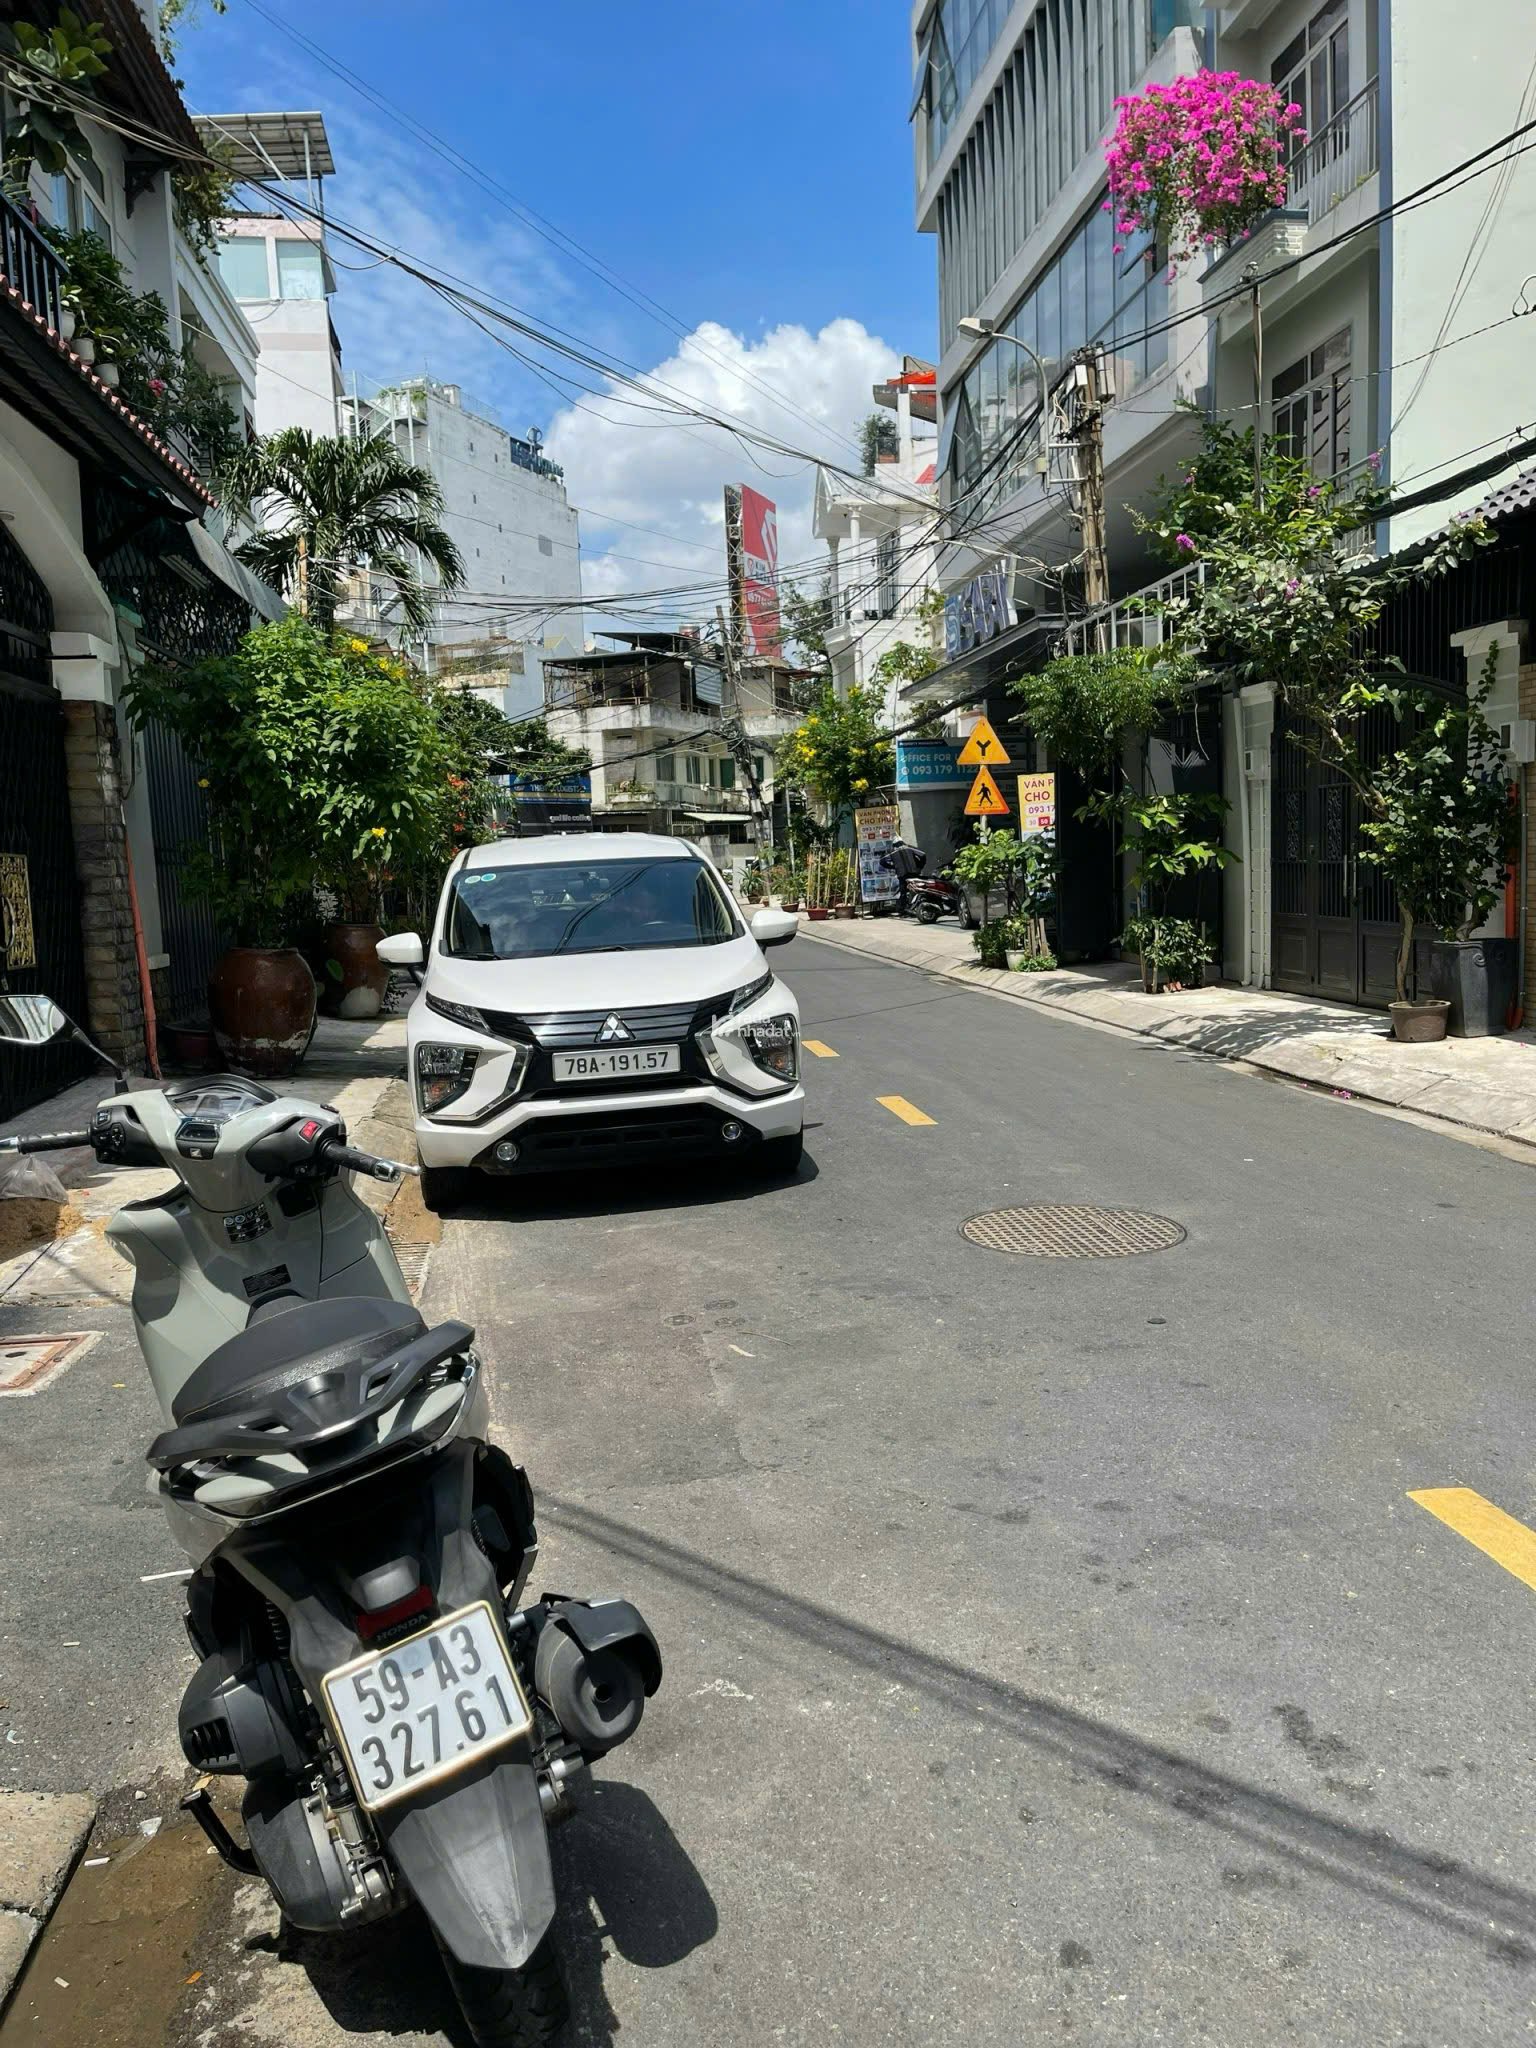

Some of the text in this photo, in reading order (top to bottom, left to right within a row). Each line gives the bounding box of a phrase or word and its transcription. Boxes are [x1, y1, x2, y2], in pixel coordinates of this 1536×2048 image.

[934, 753, 951, 761] FOR
[912, 766, 932, 775] 093
[934, 765, 953, 774] 179
[1024, 791, 1050, 802] CHO
[1029, 806, 1045, 814] 093
[564, 1051, 669, 1075] 78A-191.57
[376, 1614, 428, 1641] HONDA
[351, 1624, 482, 1724] 59-A3
[361, 1674, 514, 1790] 327.61
